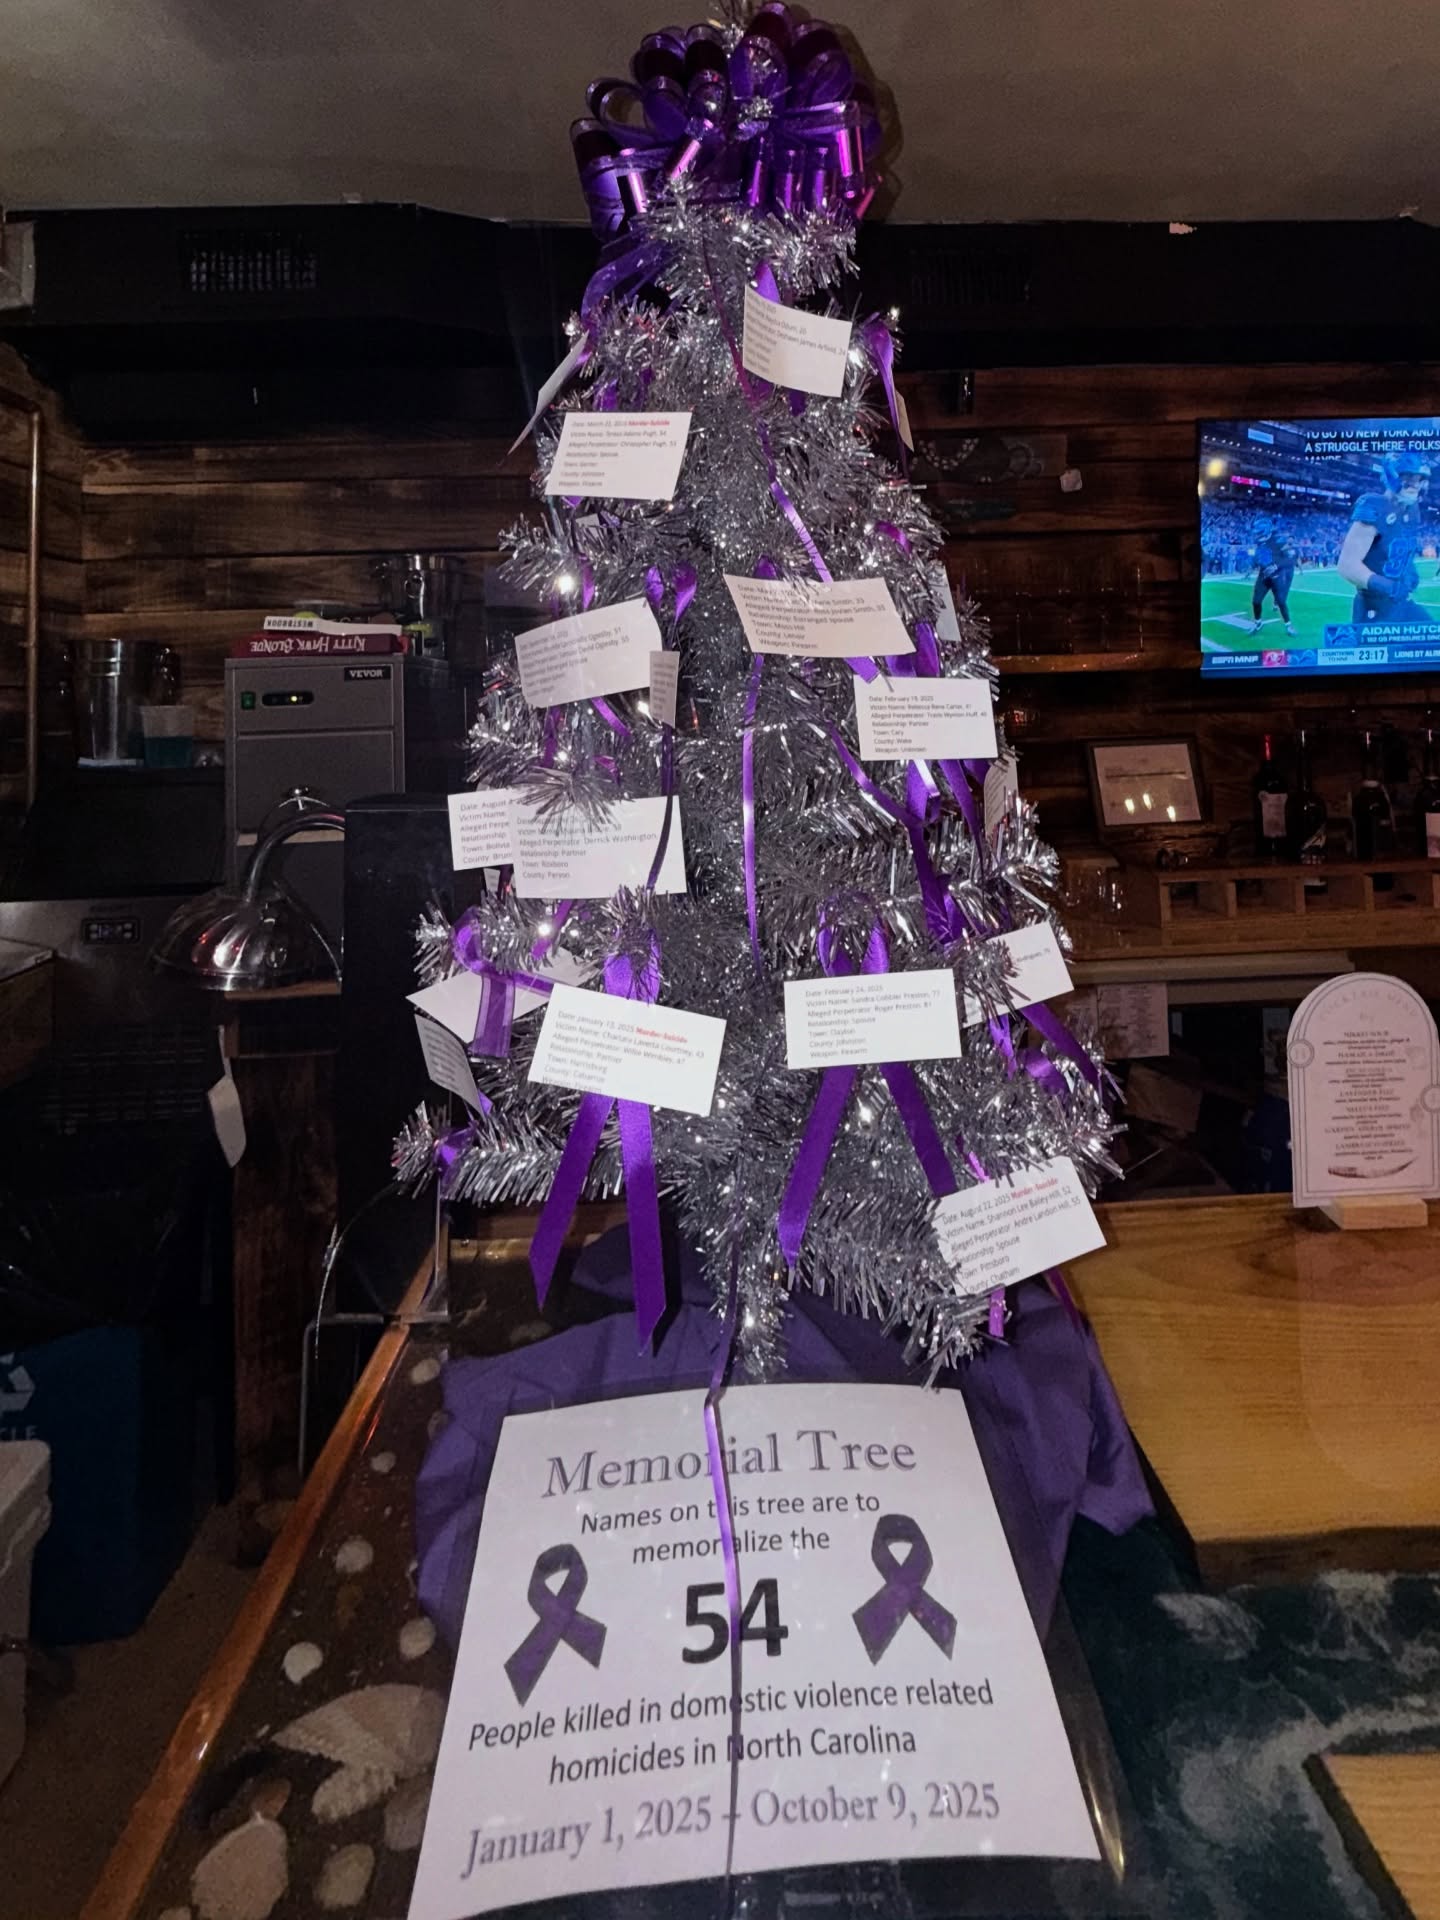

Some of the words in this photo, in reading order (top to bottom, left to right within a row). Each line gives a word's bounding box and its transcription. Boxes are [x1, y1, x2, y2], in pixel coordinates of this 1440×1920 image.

[1304, 442, 1313, 453] A
[1314, 441, 1369, 453] STRUGGLE
[1362, 626, 1400, 636] AIDAN
[250, 638, 293, 654] BLONDE
[296, 636, 329, 653] HAWK
[333, 636, 366, 652] KITTY
[1359, 650, 1385, 661] 23:17
[350, 669, 384, 678] VEVOR
[891, 729, 904, 737] Cary
[481, 800, 507, 811] August
[460, 812, 482, 821] Victim
[460, 822, 487, 833] Alleged
[584, 836, 610, 845] Derrick
[874, 1004, 894, 1012] Roger
[960, 1204, 982, 1219] August
[987, 1208, 1016, 1224] Shannon
[1016, 1203, 1029, 1214] Lee
[996, 1235, 1020, 1251] Spouse
[796, 1429, 917, 1473] Tree
[581, 1507, 662, 1535] Names
[670, 1502, 699, 1522] on
[707, 1495, 750, 1518] tis
[757, 1496, 805, 1515] tree
[812, 1495, 849, 1513] are
[856, 1493, 881, 1512] to
[633, 1528, 783, 1565] memoralize
[790, 1527, 831, 1550] the
[681, 1577, 790, 1665] 54
[468, 1711, 556, 1752] People
[563, 1699, 632, 1735] killed
[639, 1697, 662, 1724] in
[794, 1680, 898, 1710] violence
[905, 1677, 994, 1706] related
[549, 1740, 685, 1785] homicides
[693, 1736, 716, 1766] in
[810, 1723, 917, 1756] Carolina
[460, 1820, 592, 1881] January
[601, 1806, 624, 1852] 1,
[634, 1794, 712, 1841] 2025
[752, 1783, 879, 1828] October
[887, 1780, 918, 1830] 9,
[925, 1780, 1000, 1820] 2025
